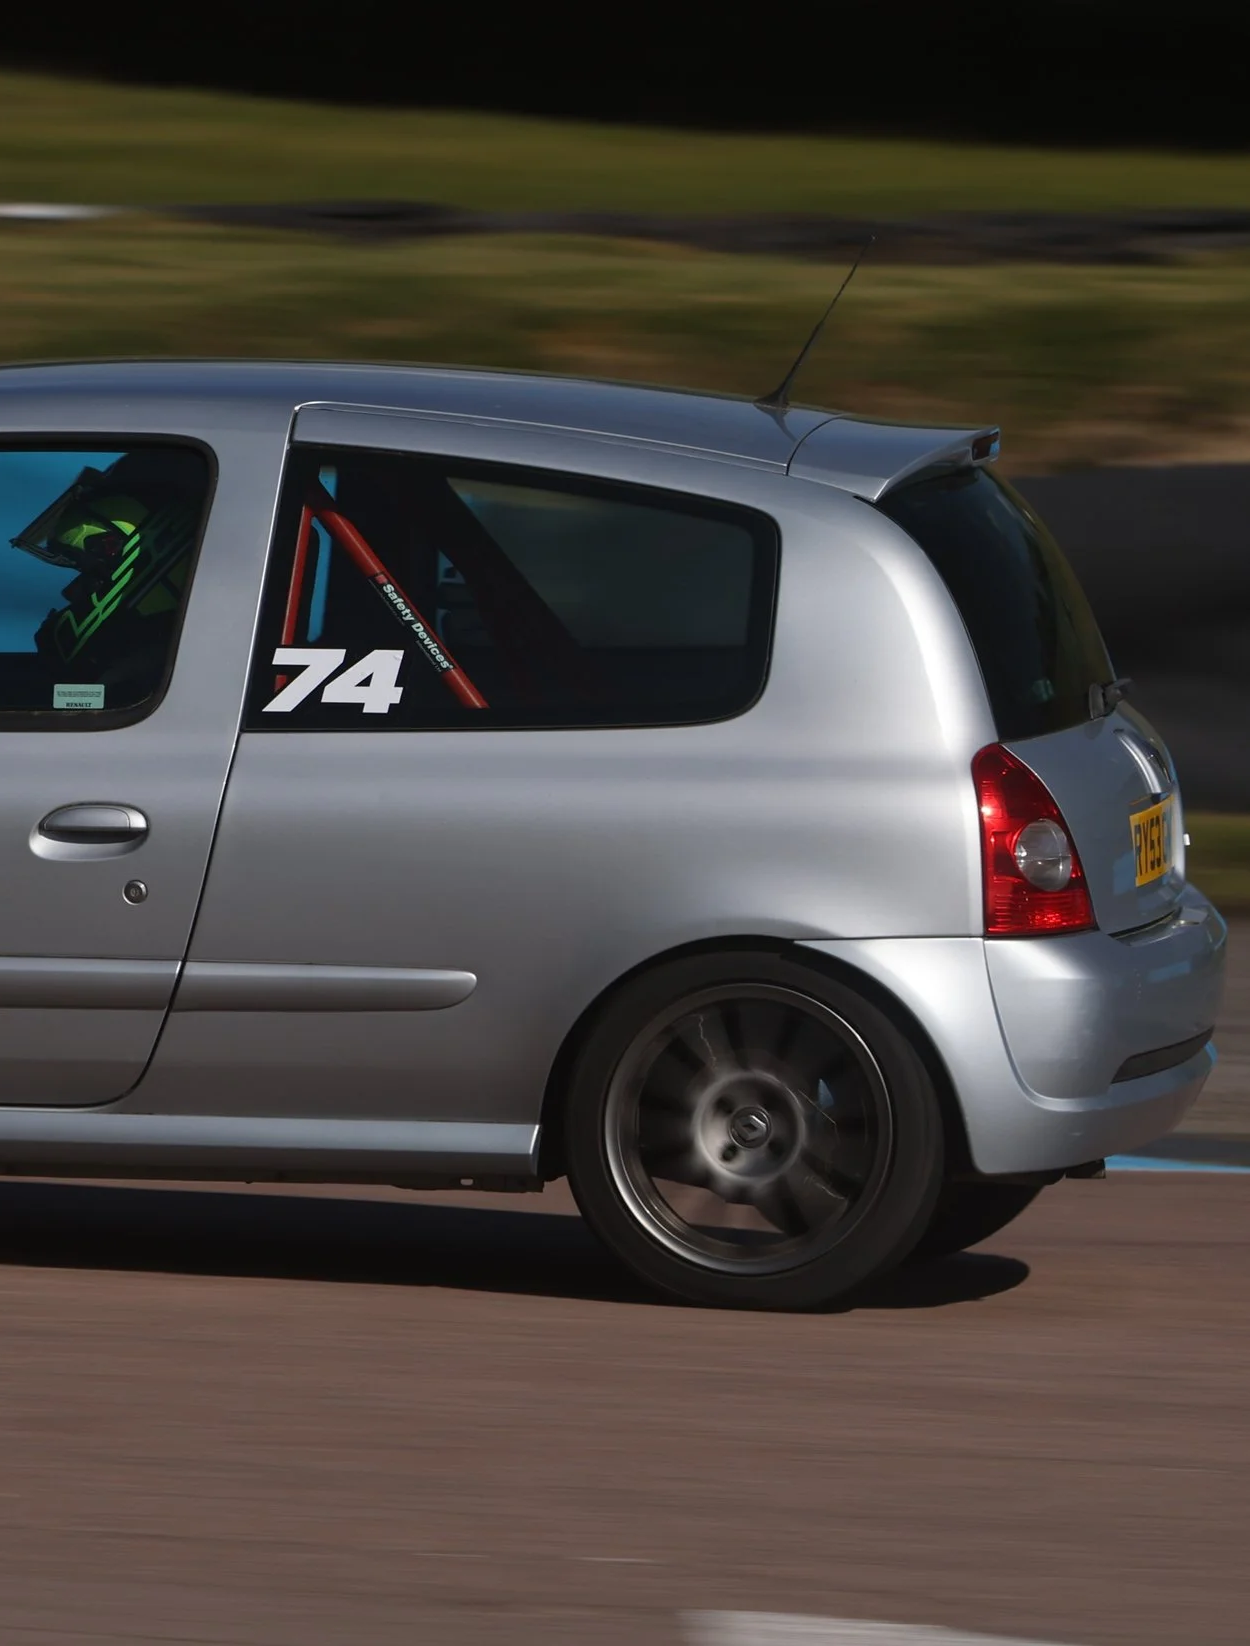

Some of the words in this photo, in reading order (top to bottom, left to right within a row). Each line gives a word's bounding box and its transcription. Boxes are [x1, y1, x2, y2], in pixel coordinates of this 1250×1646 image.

[383, 584, 415, 621] Safety
[411, 622, 450, 669] Devices
[262, 648, 405, 713] 74
